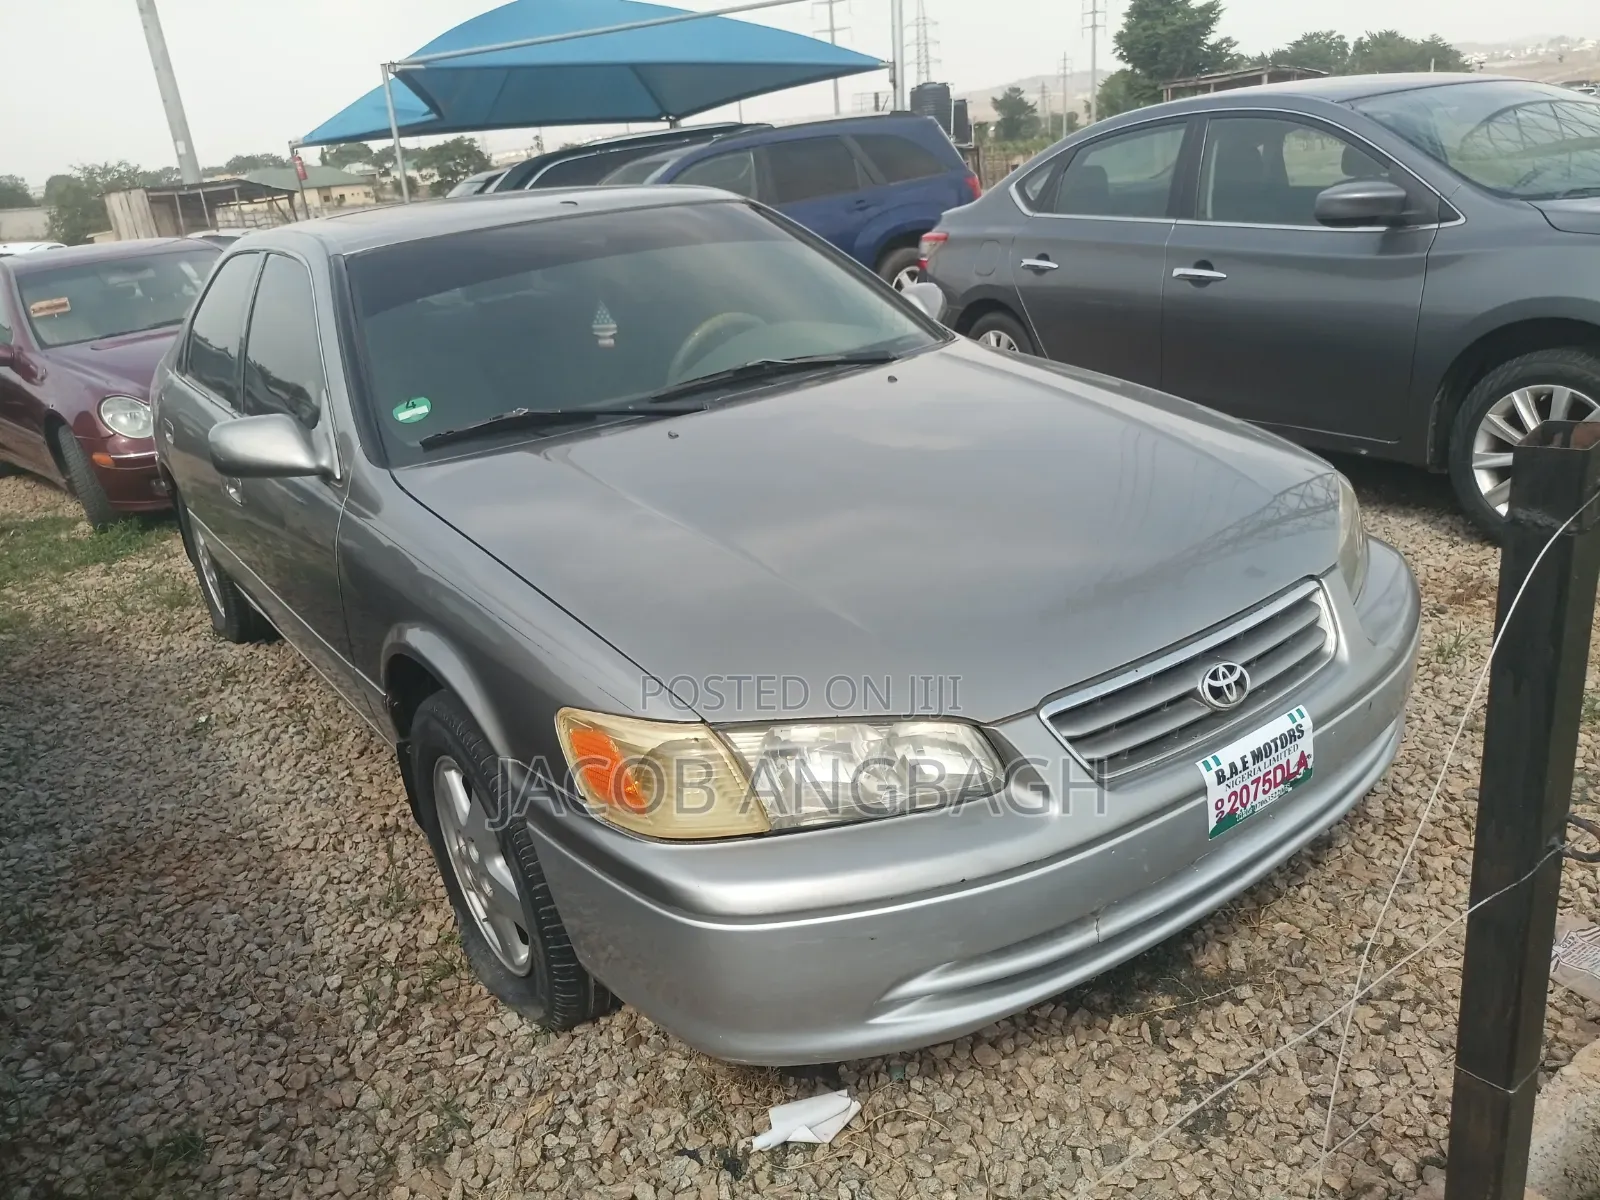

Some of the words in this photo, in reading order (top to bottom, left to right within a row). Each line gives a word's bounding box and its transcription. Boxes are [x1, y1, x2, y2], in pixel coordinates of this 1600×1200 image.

[1214, 754, 1250, 786] B.A.E
[1250, 723, 1305, 766] MOTORS
[1225, 765, 1262, 792] NIGERIA
[1263, 743, 1299, 770] LIMITED
[1227, 750, 1309, 815] 2075DLA
